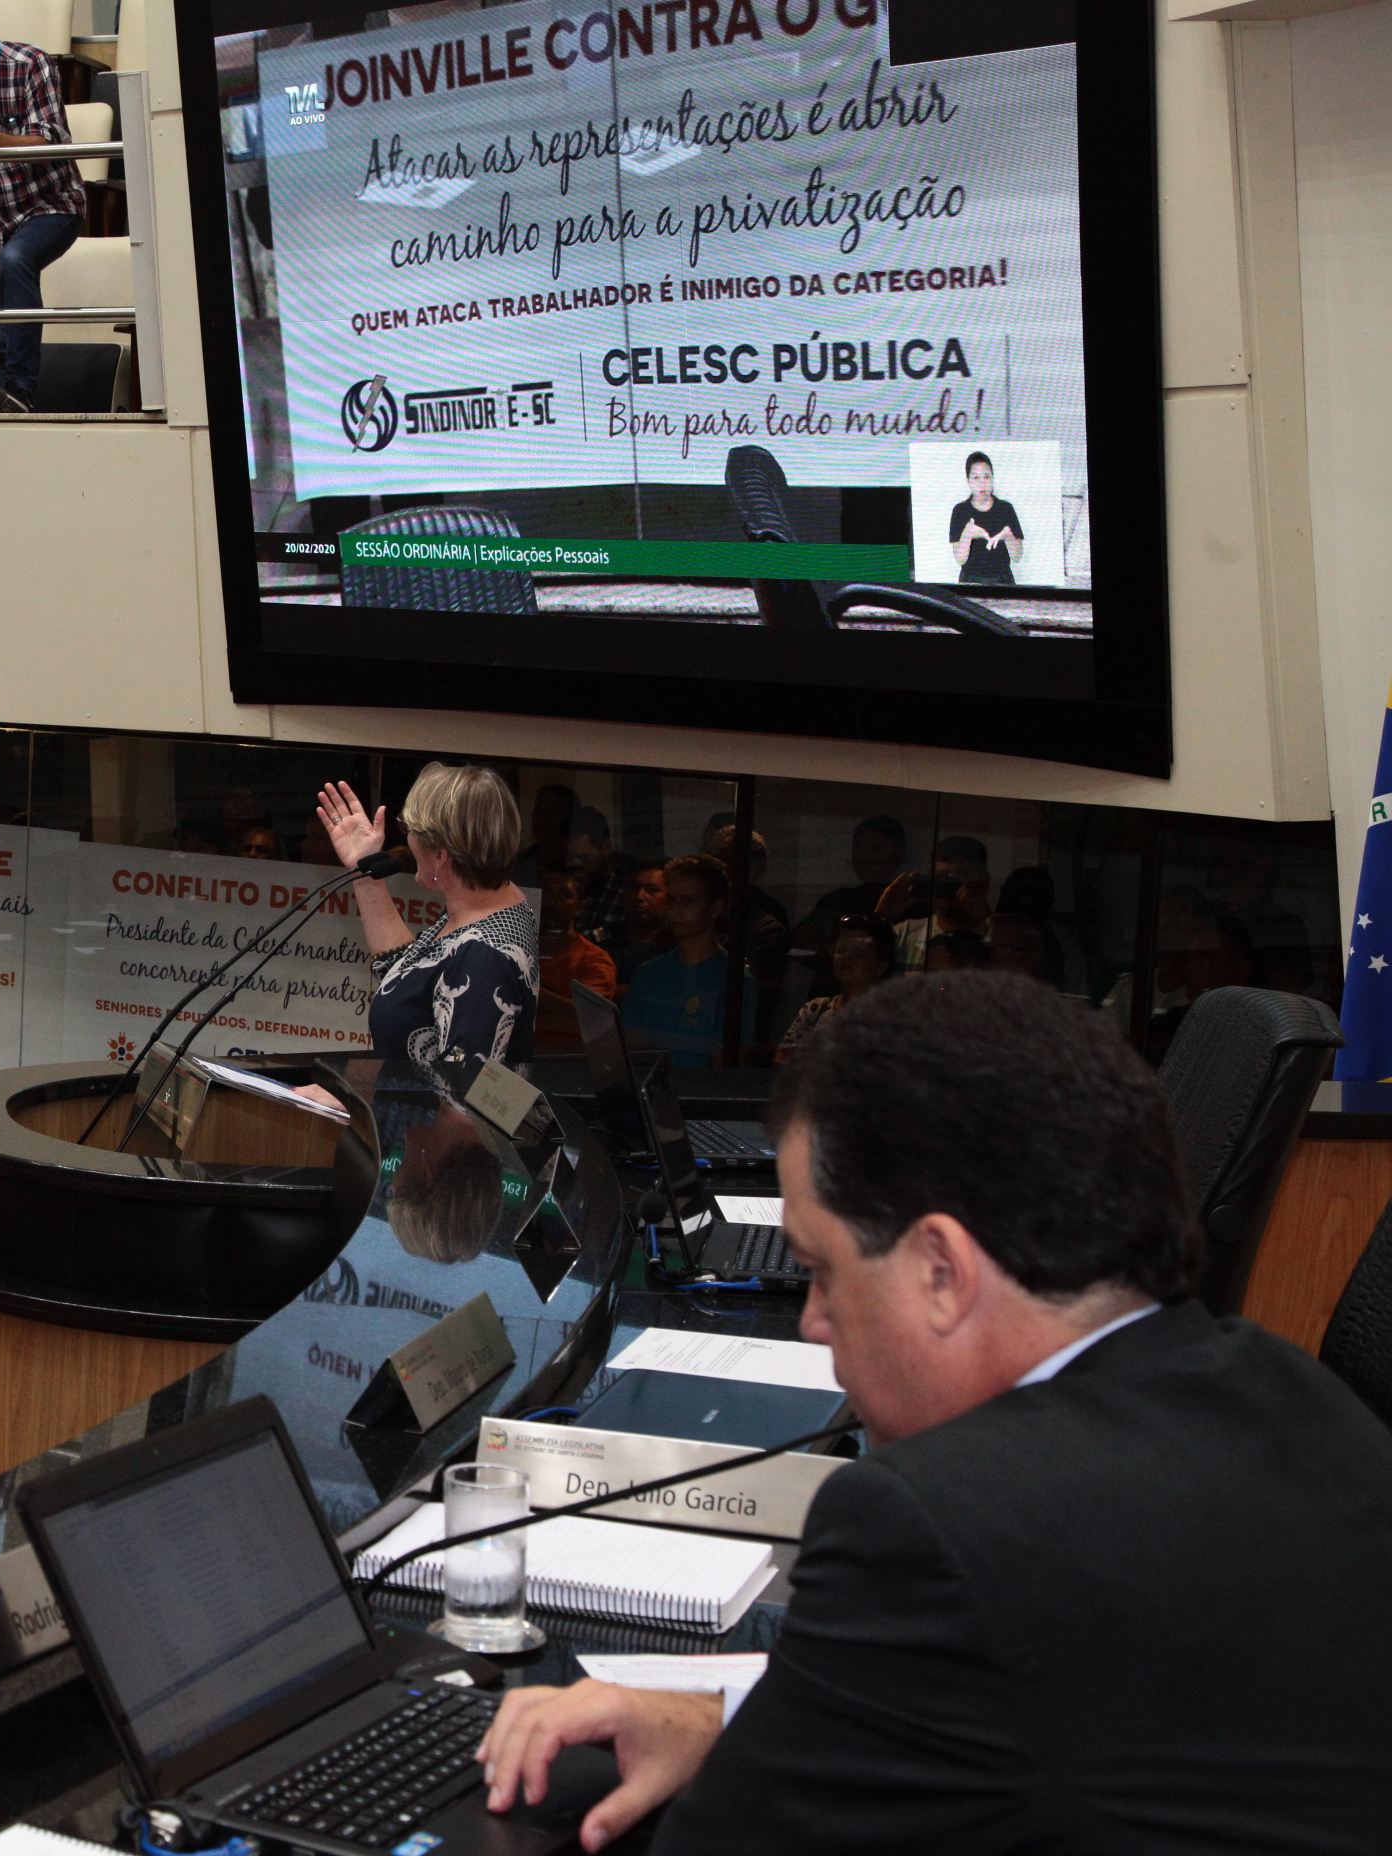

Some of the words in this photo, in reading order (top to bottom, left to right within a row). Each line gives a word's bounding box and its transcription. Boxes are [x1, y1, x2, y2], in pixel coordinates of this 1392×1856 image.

[324, 26, 534, 111] JOINVILLE
[545, 0, 763, 70] CONTRA
[290, 117, 303, 126] AO
[305, 114, 325, 125] VIVO
[353, 134, 476, 198] Atacar
[483, 135, 524, 173] as
[530, 88, 799, 196] representações
[808, 82, 833, 135] é
[839, 58, 958, 132] abrir
[391, 191, 540, 268] caminho
[552, 205, 646, 280] para
[656, 206, 683, 236] a
[689, 166, 966, 268] privatização
[351, 308, 408, 336] QUEM
[415, 301, 482, 327] ATACA
[487, 283, 653, 319] TRABALHADOR
[660, 274, 674, 303] É
[681, 276, 781, 301] INIMIGO
[788, 274, 826, 297] DA
[832, 257, 1008, 295] CATEGORIA!
[602, 343, 760, 387] CELESC
[773, 330, 972, 383] PÚBLICA
[605, 395, 678, 437] Bom
[680, 408, 757, 459] para
[765, 391, 833, 437] todo
[845, 388, 985, 436] mundo!
[285, 542, 336, 555] 20/02/2020
[356, 540, 400, 559] SESSÃO
[403, 541, 471, 561] ORDINÁRIA
[480, 546, 553, 567] Explicações
[555, 547, 610, 566] Pessoais
[112, 869, 260, 906] CONFLITO
[269, 884, 309, 910] DE
[106, 913, 199, 946] Presidente
[201, 922, 229, 949] da
[95, 999, 163, 1019] SENHORES
[255, 1019, 331, 1041] DEFENDAM
[334, 1030, 346, 1042] O
[560, 1439, 606, 1451] LEGISLATIVA
[685, 1486, 758, 1517] Garcia
